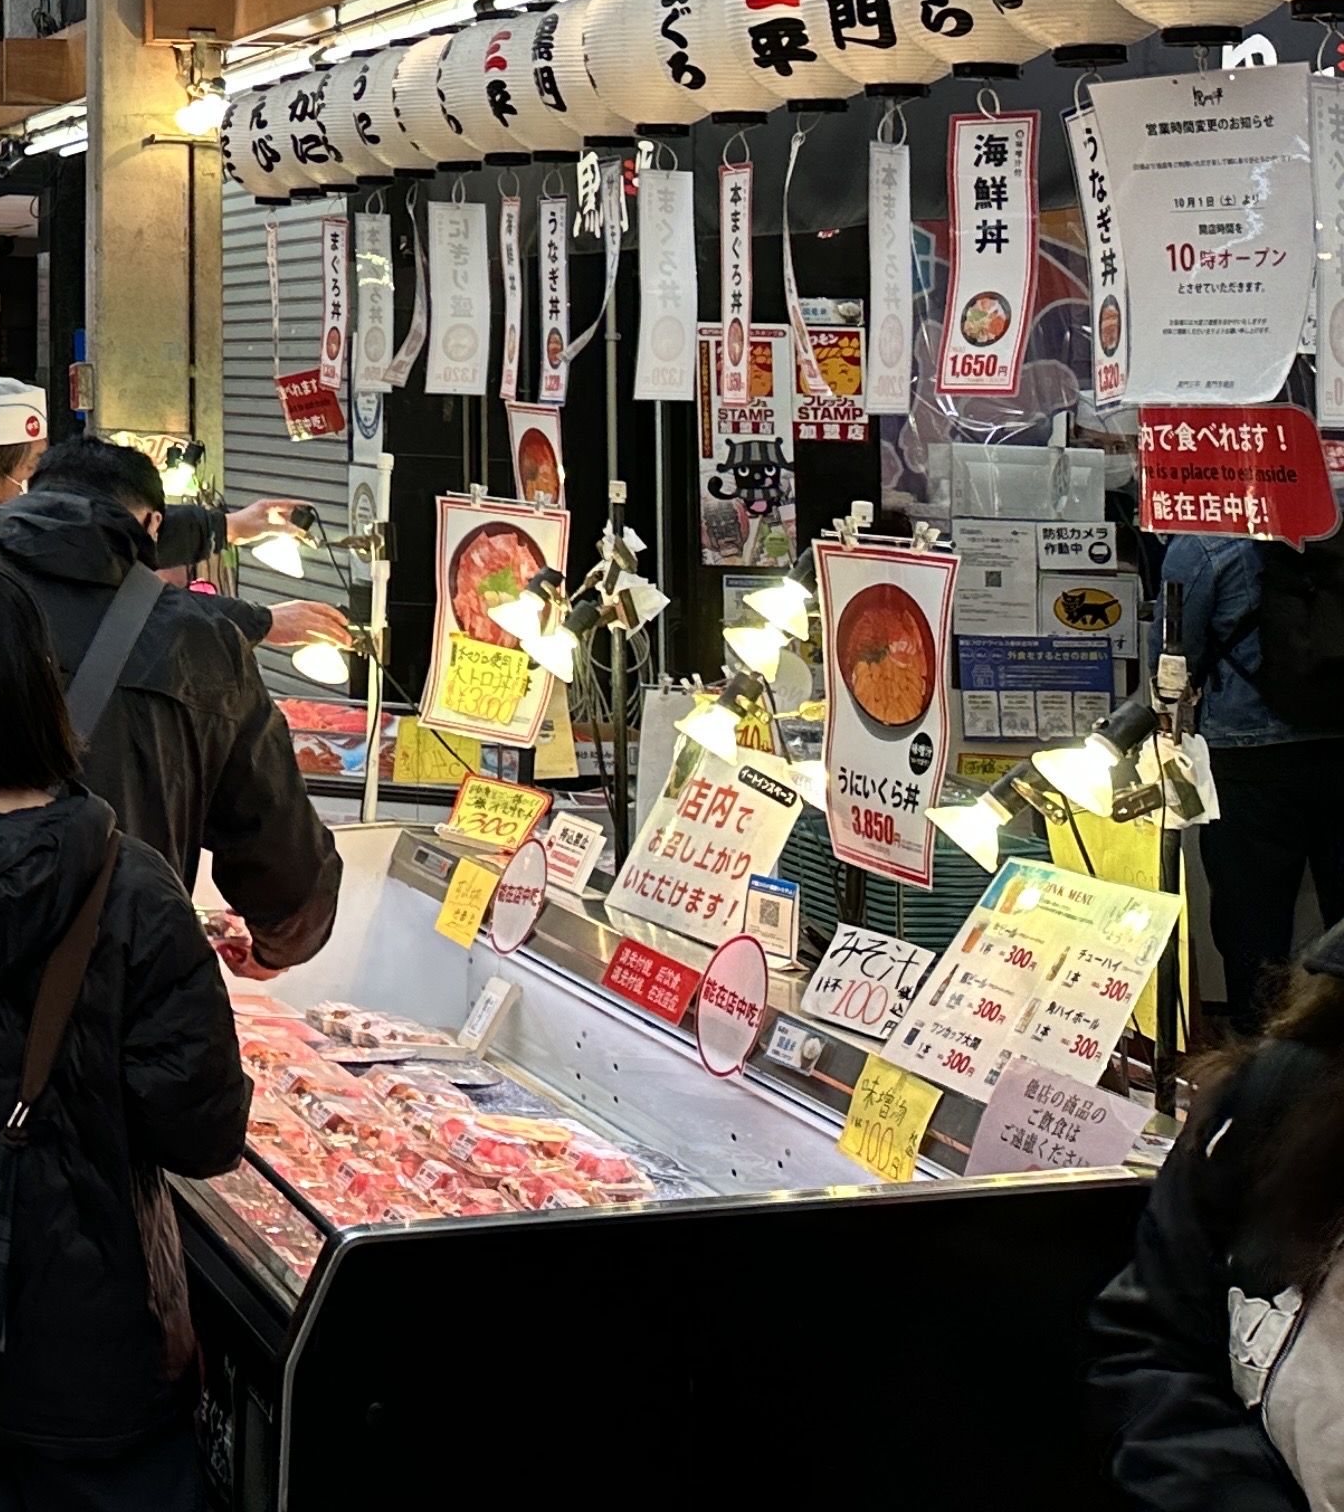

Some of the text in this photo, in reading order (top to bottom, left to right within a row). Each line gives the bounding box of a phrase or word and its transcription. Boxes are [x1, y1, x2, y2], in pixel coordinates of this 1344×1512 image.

[531, 13, 567, 112] 黒門
[484, 31, 518, 128] 三平
[250, 95, 281, 173] えび
[1145, 115, 1275, 137] 営業時間変更のお知らせ
[973, 134, 1009, 254] 海鮮丼
[1083, 127, 1118, 287] うなぎ丼
[729, 183, 743, 314] 本まぐろ丼
[1165, 242, 1287, 273] 10時オープン
[330, 231, 342, 321] まぐろ丼
[546, 212, 561, 321] うなぎ丼
[949, 354, 1008, 378] 1,650円
[718, 409, 775, 421] STAMP
[798, 407, 864, 420] STAMP
[1156, 463, 1168, 480] is
[1170, 467, 1179, 479] a
[1182, 463, 1219, 483] place
[1222, 465, 1236, 480] to
[1153, 491, 1269, 524] 能在店中吃!
[1042, 527, 1108, 540] 防犯カメラ
[1044, 542, 1083, 556] 作動中
[740, 768, 794, 805] イートインスペース
[838, 765, 920, 814] うにいくら丼
[677, 777, 755, 834] 店内で
[647, 826, 753, 881] お召し上がり
[622, 864, 740, 926] いただけます！
[830, 931, 920, 989] みそ汁
[1004, 945, 1038, 971] 300円
[1077, 948, 1123, 972] チューハイ
[829, 979, 889, 1026] 100
[1099, 977, 1133, 1004] 300円
[973, 997, 1007, 1024] 300円
[1046, 1001, 1100, 1031] 角ハイボール
[930, 1022, 982, 1051] ワンカップ大関
[1069, 1035, 1102, 1063] 300円
[943, 1048, 976, 1078] 300円
[1027, 1107, 1081, 1143] ご飲食は
